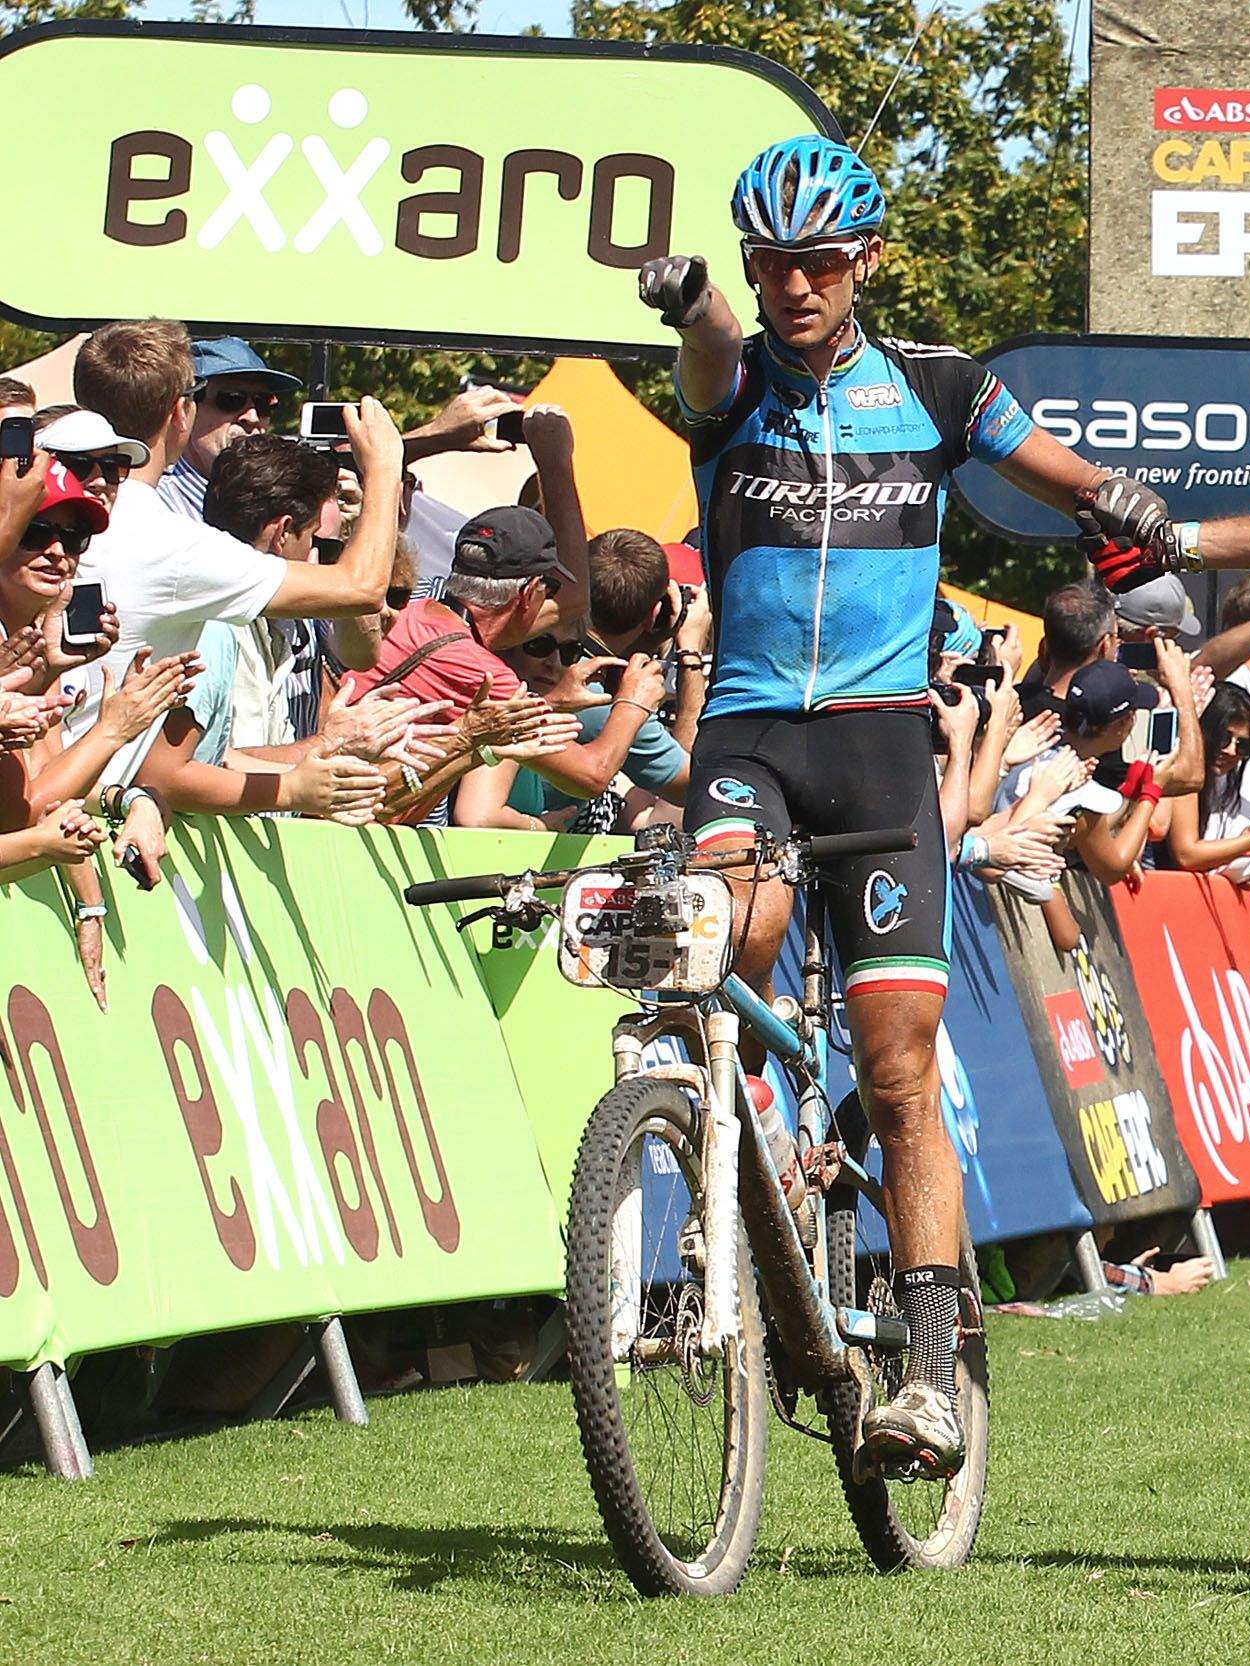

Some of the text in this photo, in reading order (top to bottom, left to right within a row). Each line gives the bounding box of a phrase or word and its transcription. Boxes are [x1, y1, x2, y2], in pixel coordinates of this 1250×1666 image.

[103, 129, 675, 269] exxaro
[730, 471, 933, 505] TORPADO
[1135, 467, 1182, 484] new
[769, 506, 887, 522] FACTORY
[576, 912, 636, 937] CAP
[152, 984, 461, 1272] exxaro
[1079, 1089, 1168, 1205] CAPE EPIC
